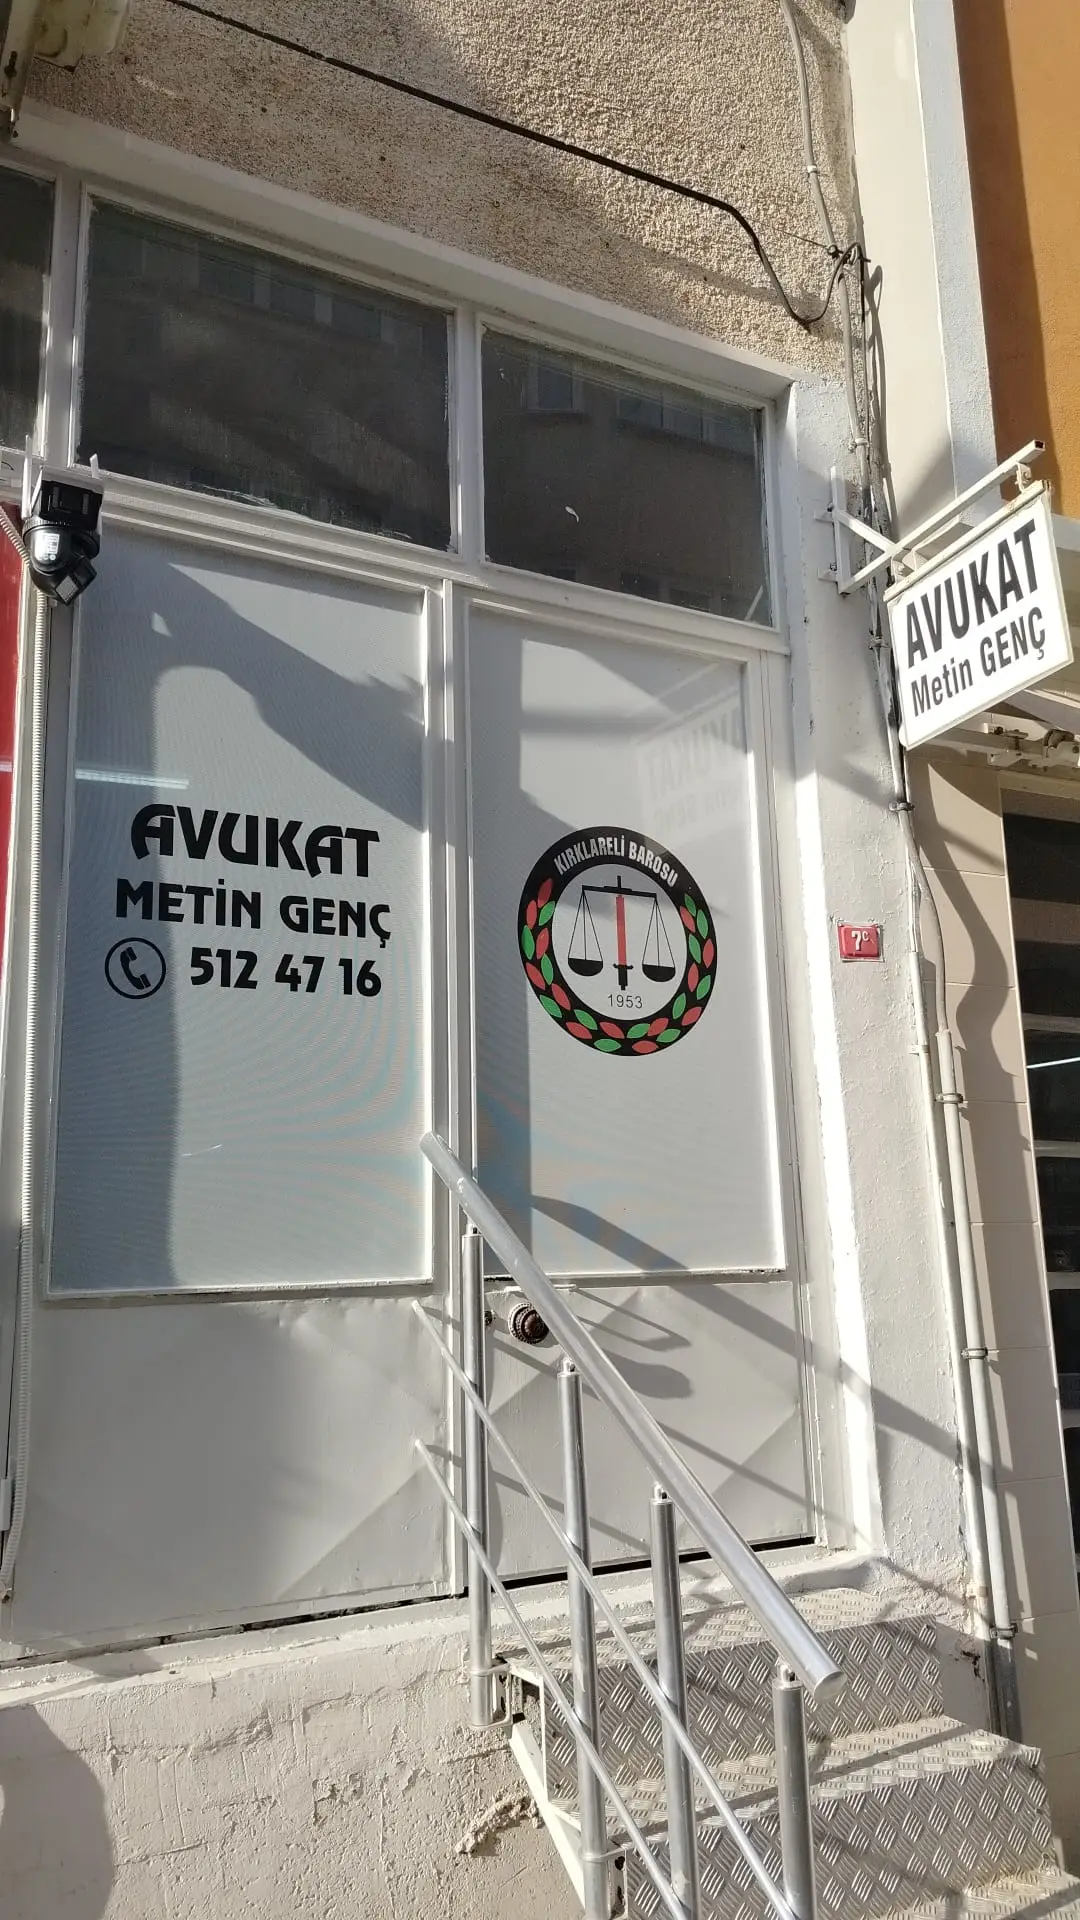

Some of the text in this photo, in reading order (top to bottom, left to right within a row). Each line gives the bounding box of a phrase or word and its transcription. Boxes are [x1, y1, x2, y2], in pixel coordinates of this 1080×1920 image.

[906, 518, 1037, 669] AVUKAT
[911, 606, 1046, 717] Metin GENÇ
[131, 804, 380, 878] AVUKAT
[554, 835, 678, 887] KIRKLARELİ BAROSU
[116, 878, 391, 948] METİN GENÇ
[190, 946, 382, 997] 512 47 16
[608, 994, 643, 1009] 1953
